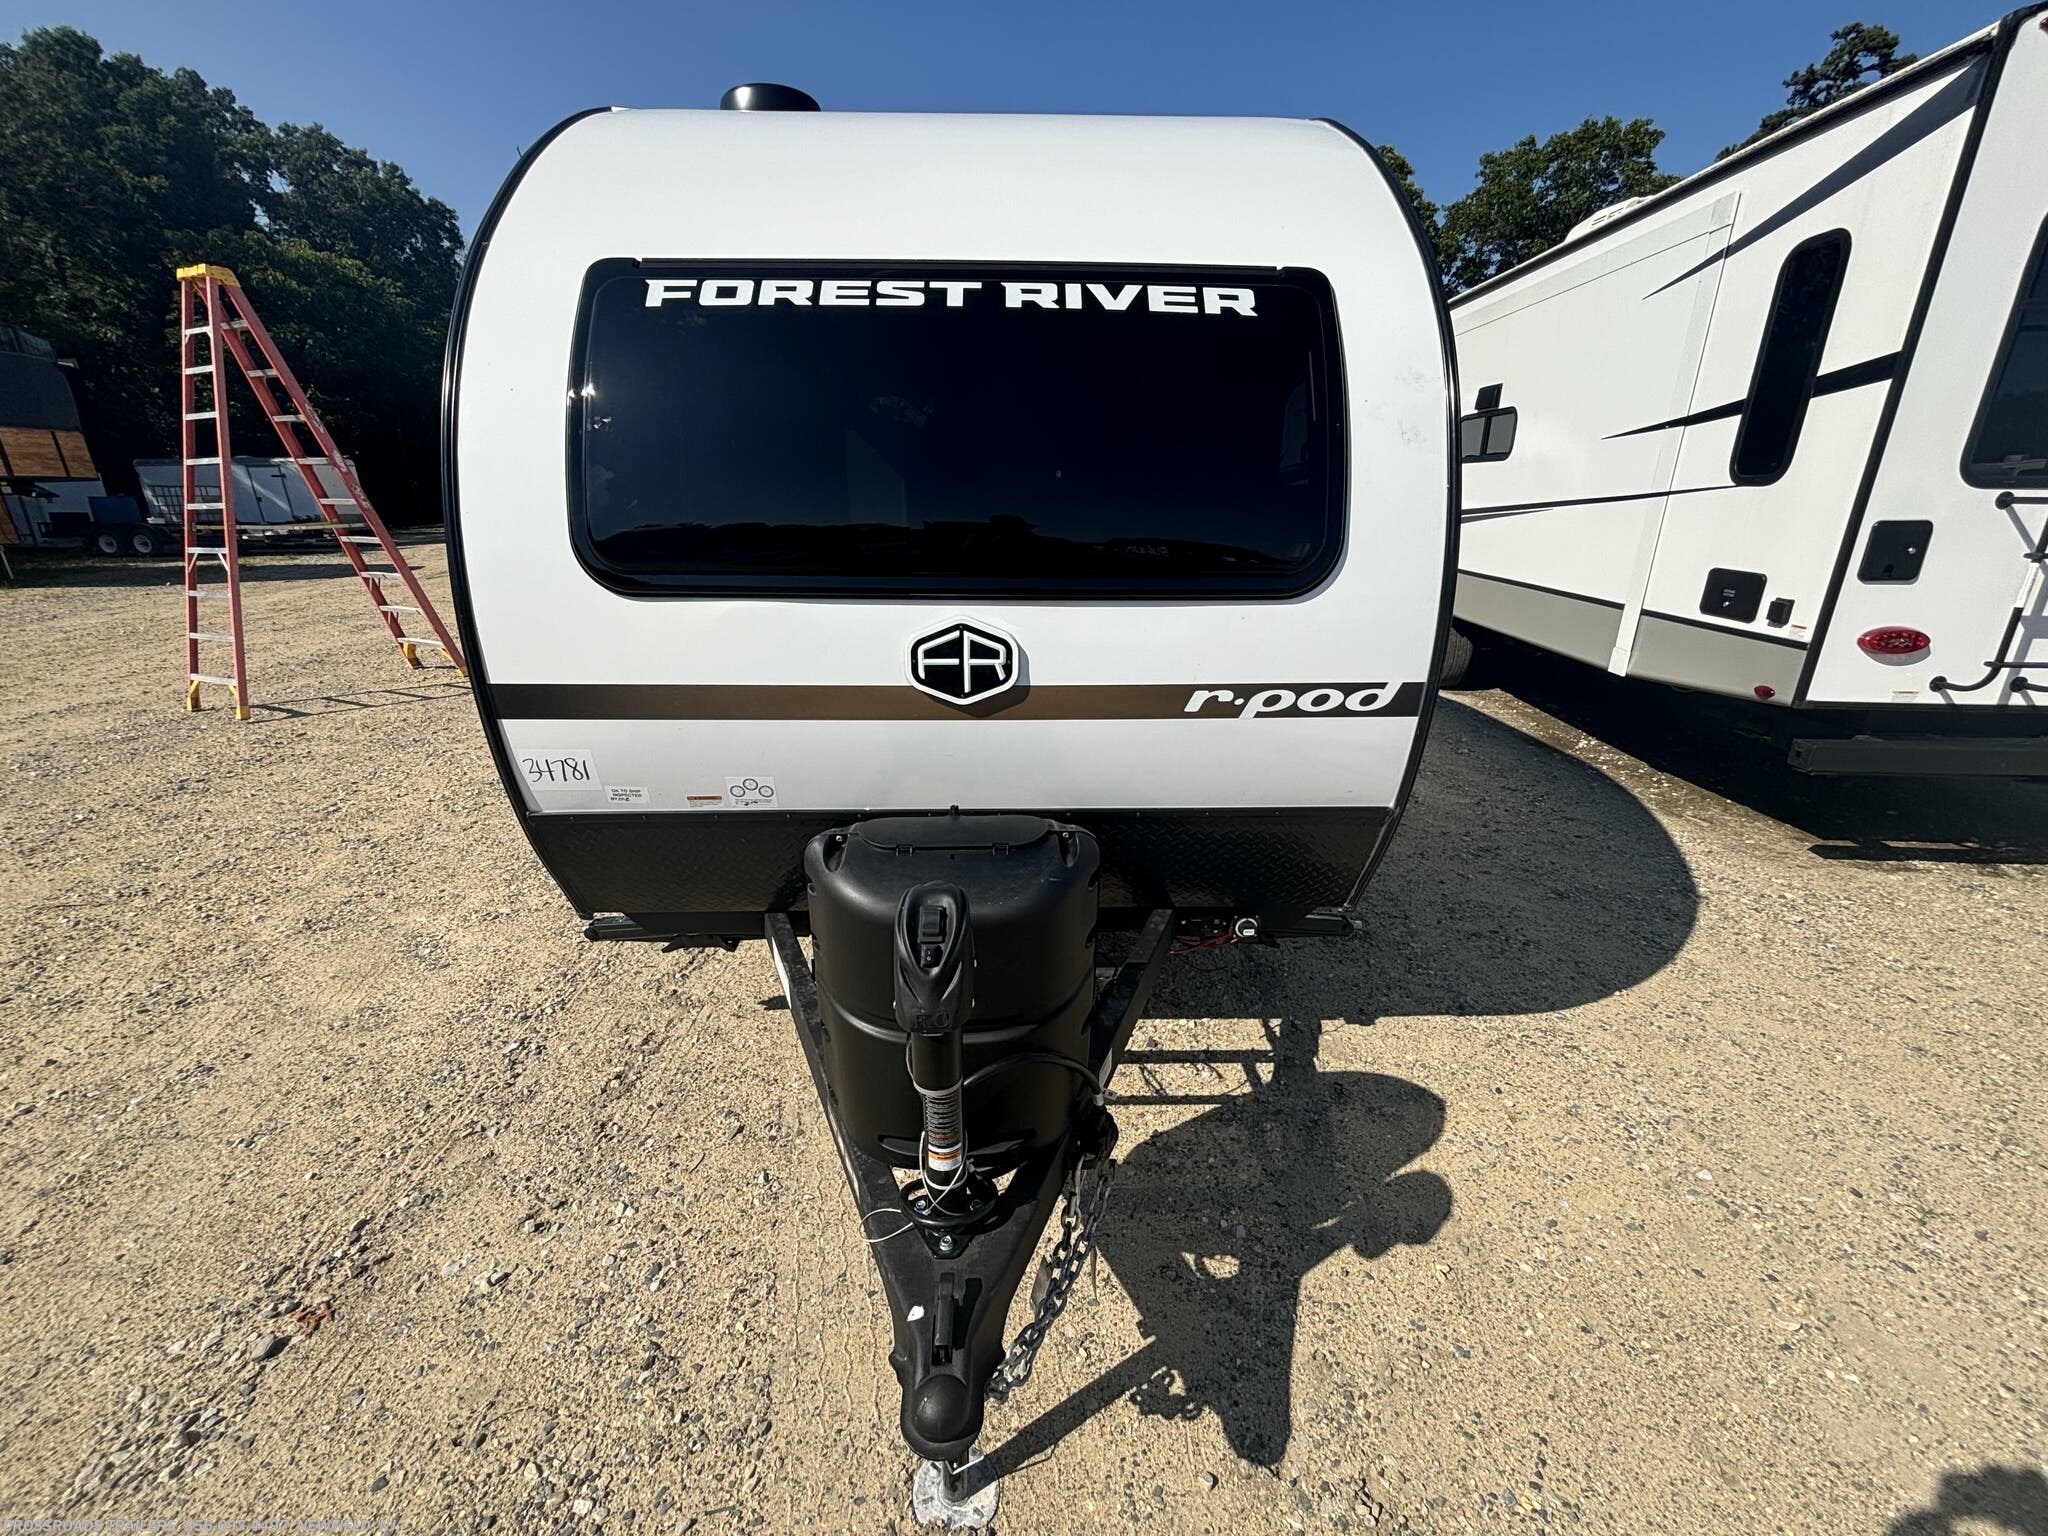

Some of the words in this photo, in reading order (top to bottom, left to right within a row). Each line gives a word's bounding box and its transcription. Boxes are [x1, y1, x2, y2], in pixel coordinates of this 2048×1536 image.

[645, 279, 982, 308] FOREST
[1000, 281, 1258, 317] RIVER
[522, 757, 590, 782] 34781
